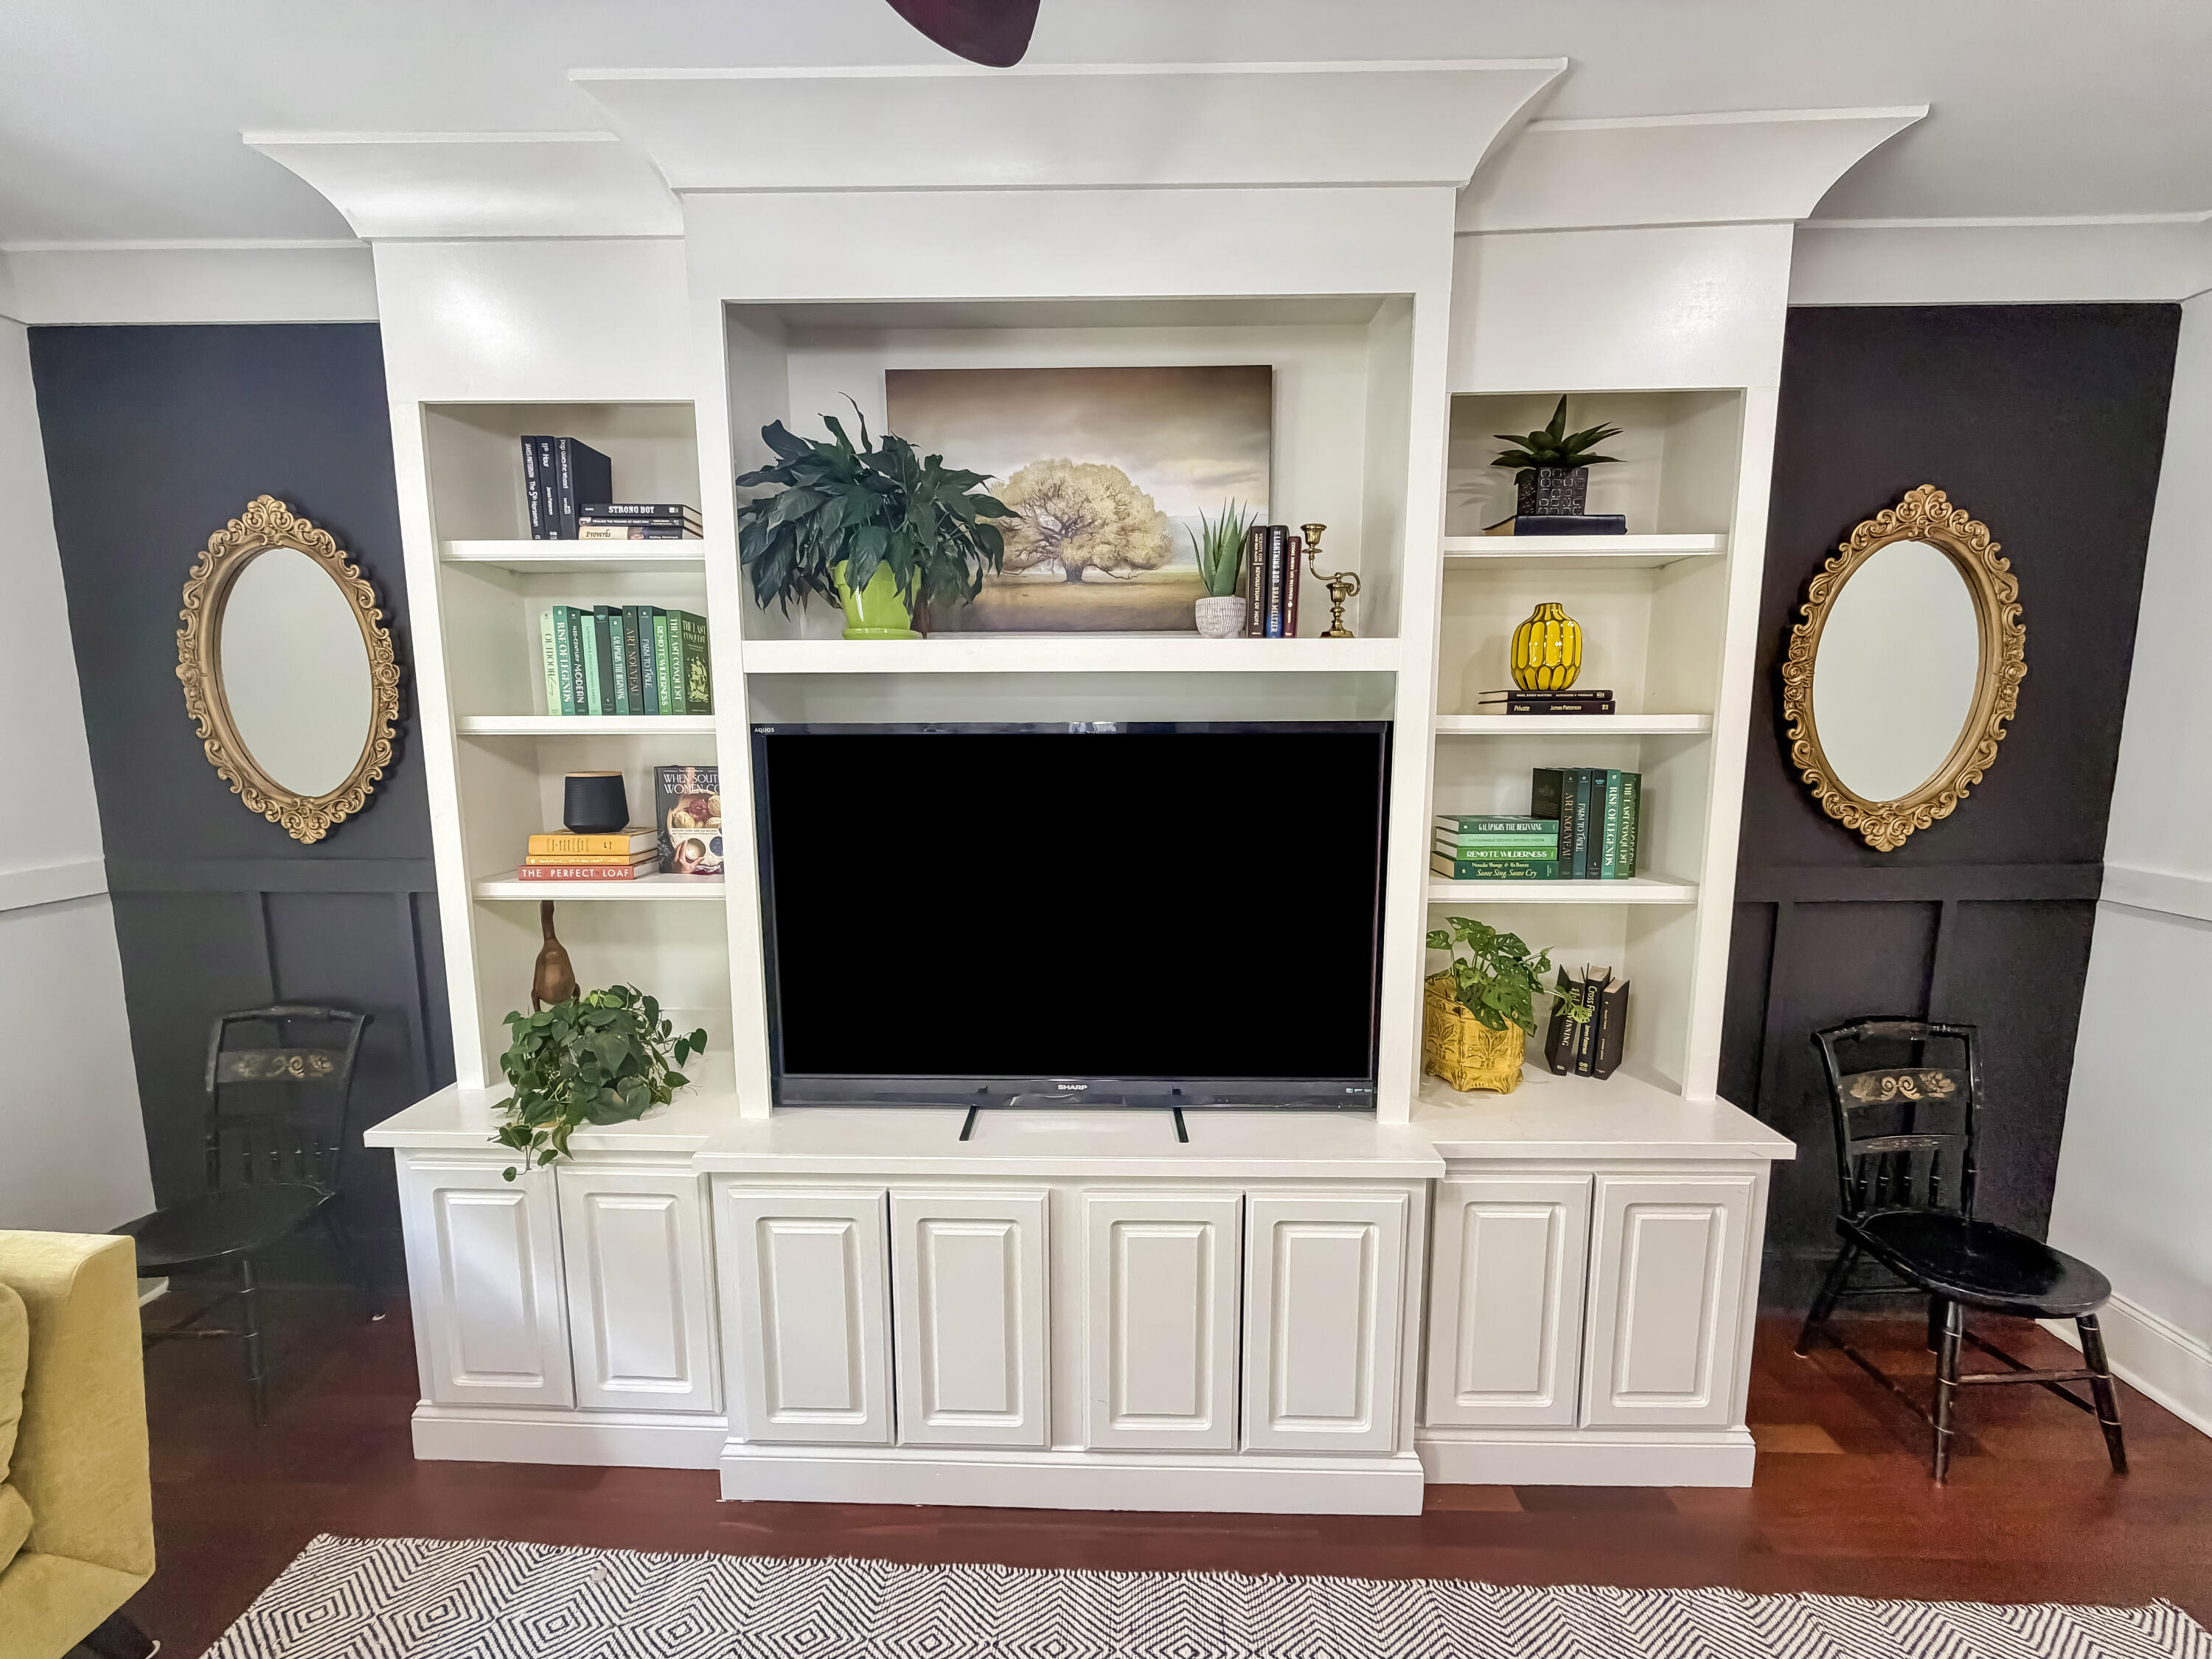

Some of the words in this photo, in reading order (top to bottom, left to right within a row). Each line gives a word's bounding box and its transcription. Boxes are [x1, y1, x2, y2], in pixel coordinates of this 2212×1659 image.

[585, 529, 611, 538] Proverbs
[1273, 536, 1281, 568] LIGHTNING
[670, 619, 678, 633] THE
[682, 620, 692, 632] THE
[693, 622, 706, 635] LAST
[1270, 605, 1279, 633] MELTZER
[557, 622, 566, 643] RISE
[626, 628, 636, 647] ART
[657, 625, 665, 658] REMOTE
[559, 644, 568, 658] OF
[642, 639, 650, 656] FARM
[671, 635, 679, 655] LAST
[546, 634, 555, 676] OUTDOOR
[643, 658, 651, 668] TO
[614, 663, 623, 673] THE
[628, 651, 639, 696] NOUVEAU
[560, 659, 572, 702] LEGENDS
[574, 664, 585, 703] MODERN
[616, 674, 625, 700] BEGINNING
[644, 669, 653, 688] TABLE
[659, 659, 668, 706] WILDERNESS
[672, 657, 682, 700] CONQUEST
[664, 773, 689, 783] WHEN
[664, 784, 703, 794] WOMEN
[1608, 787, 1618, 807] RISE
[1624, 783, 1632, 798] THE
[1565, 793, 1573, 812] ART
[1577, 803, 1586, 821] FARM
[1622, 799, 1631, 819] LAST
[1607, 808, 1616, 822] OF
[1576, 821, 1585, 832] TO
[1562, 815, 1573, 860] NOUVEAU
[1576, 832, 1586, 852] TABLE
[1605, 824, 1615, 866] LEGENDS
[1619, 821, 1629, 863] CONQUEST
[522, 869, 542, 877] THE
[551, 869, 594, 877] PERFECT
[602, 869, 629, 877] LOAF
[1525, 869, 1537, 878] Cry
[1587, 986, 1598, 1004] Cross
